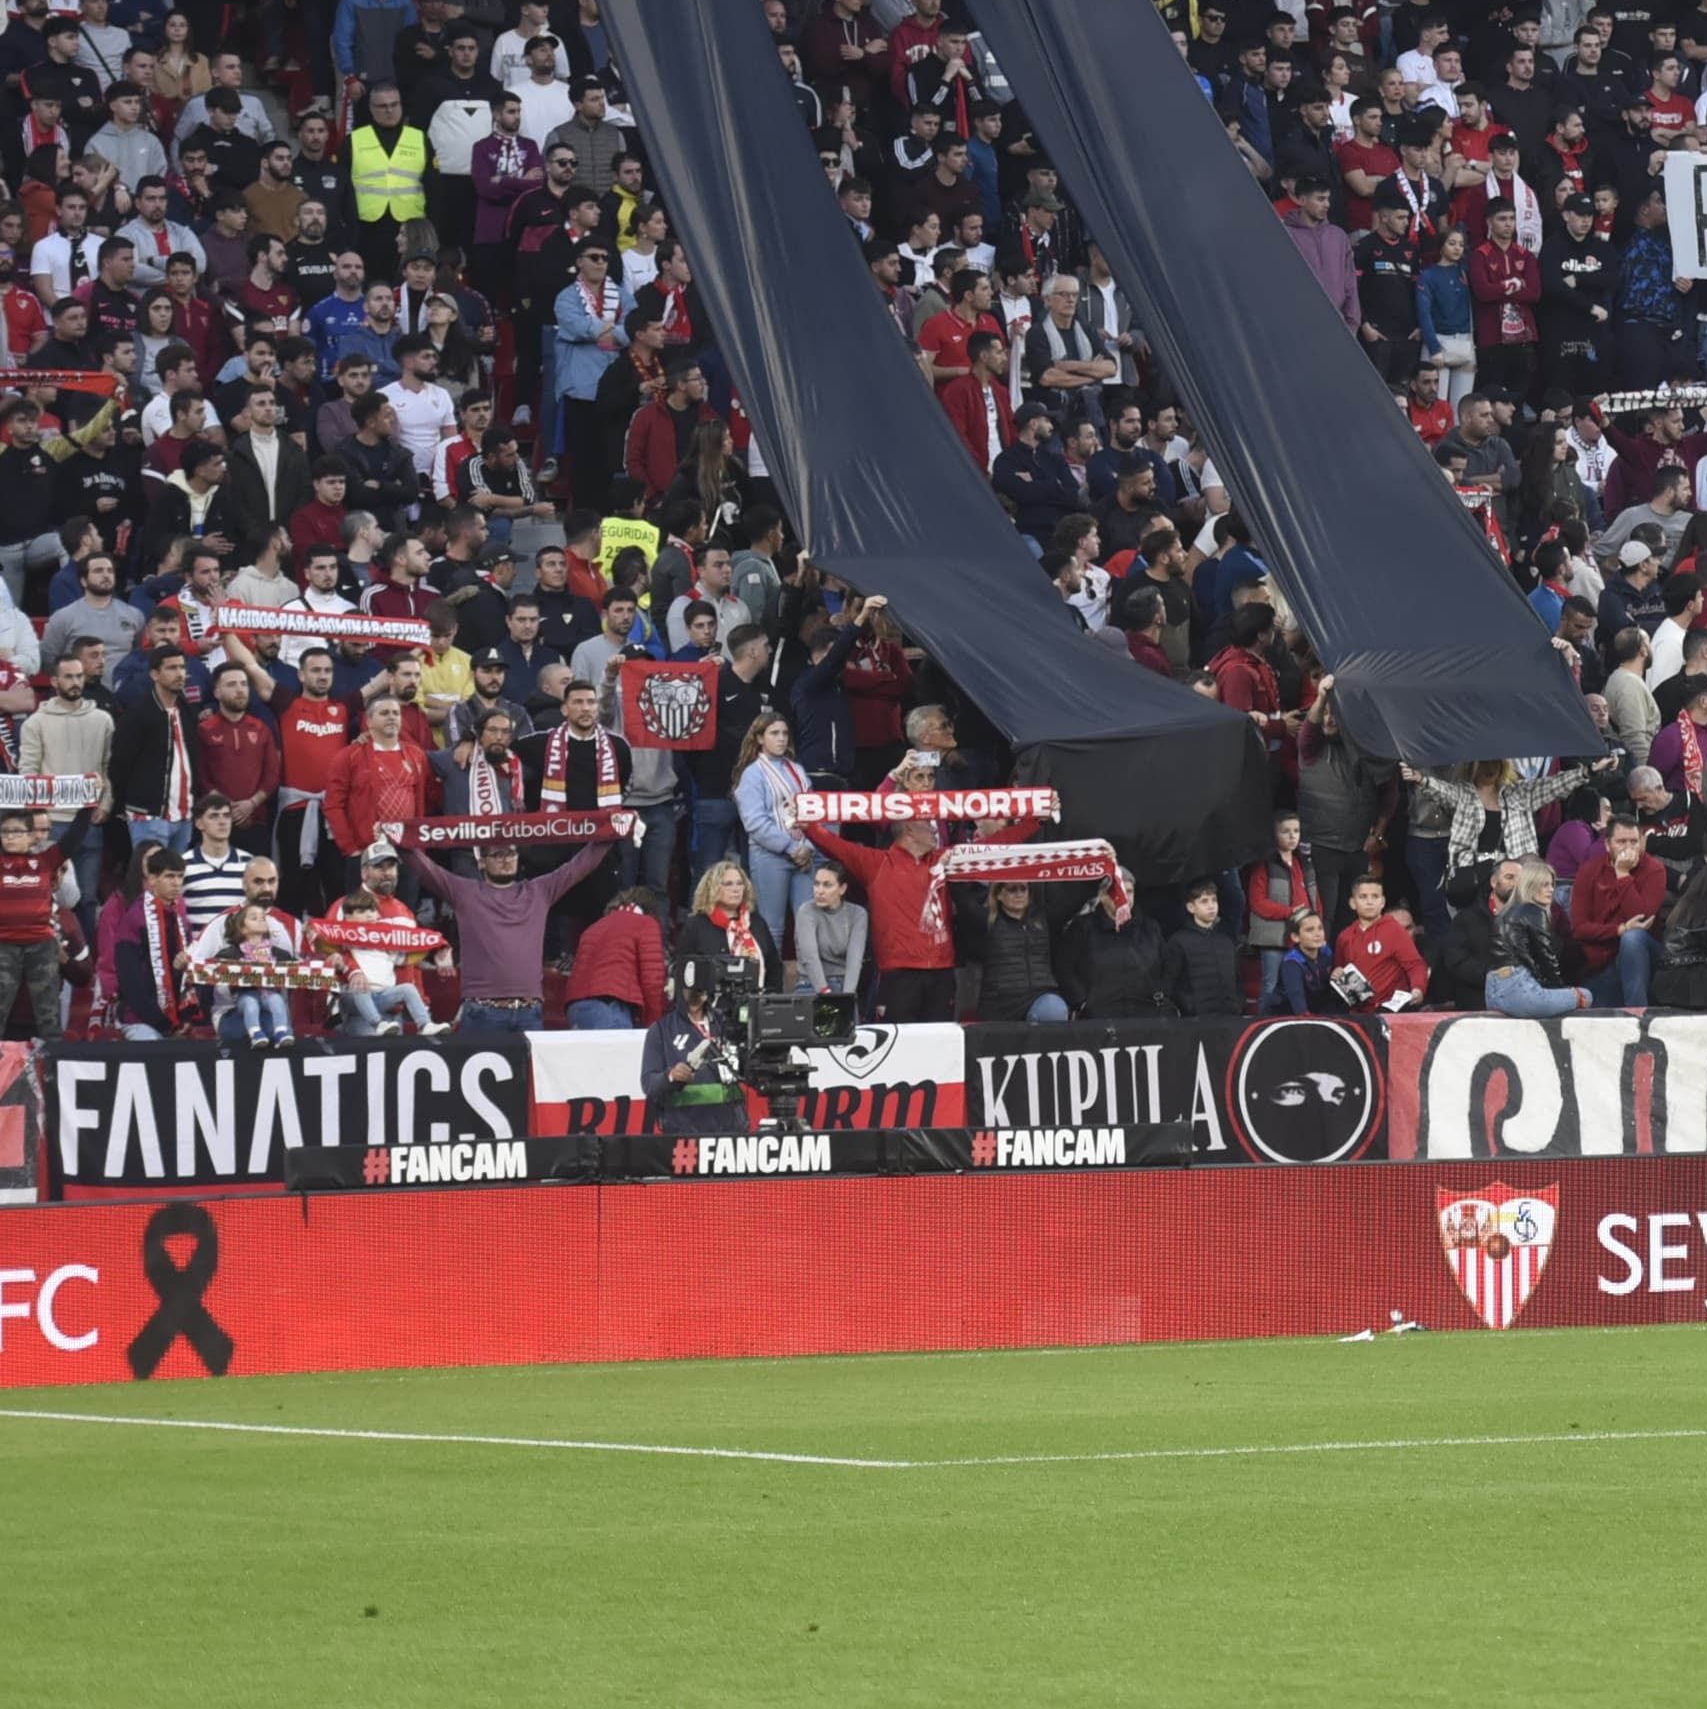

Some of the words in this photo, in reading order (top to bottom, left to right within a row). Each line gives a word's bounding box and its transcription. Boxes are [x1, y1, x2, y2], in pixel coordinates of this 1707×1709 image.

[602, 524, 656, 545] EGURIDAD
[604, 546, 623, 561] 25
[488, 647, 498, 660] A
[36, 777, 51, 806] EL
[53, 777, 82, 806] PUTO
[795, 792, 914, 823] BIRIS
[938, 789, 1052, 819] NORTE
[56, 1049, 516, 1179] FANATICS
[362, 1139, 528, 1185] #FANCAM
[671, 1132, 832, 1177] #FANCAM
[971, 1127, 1127, 1167] #FANCAM
